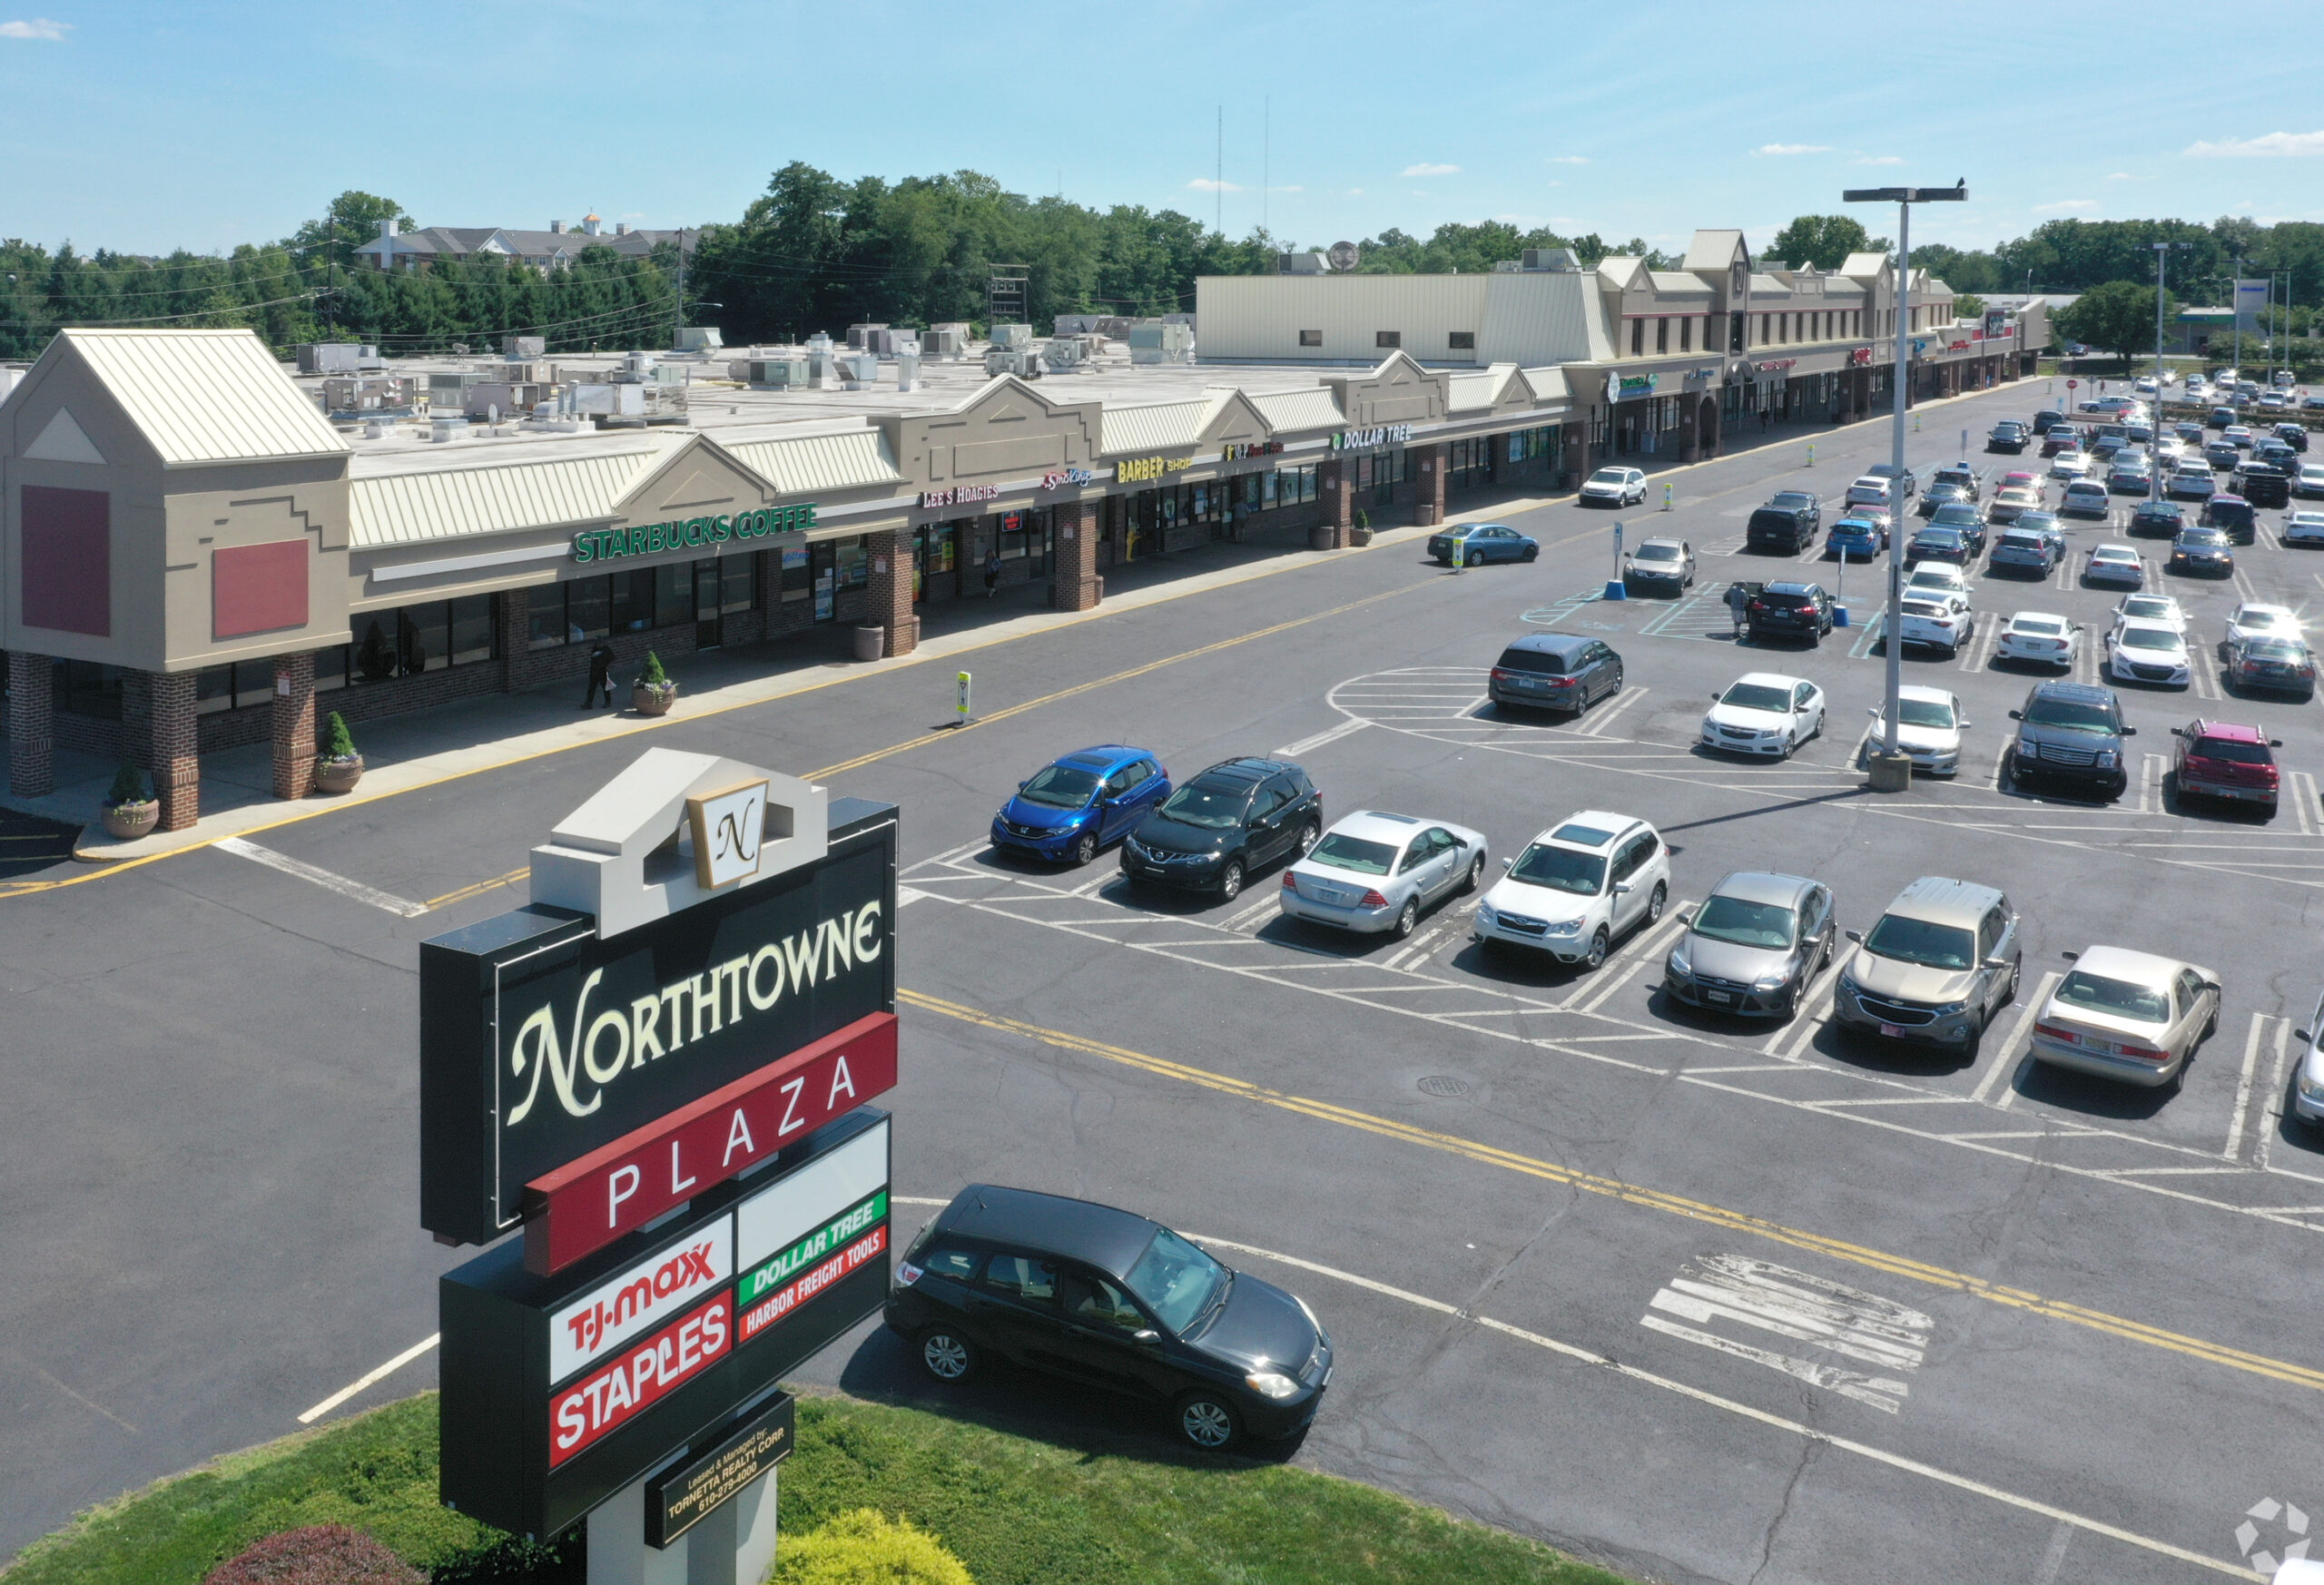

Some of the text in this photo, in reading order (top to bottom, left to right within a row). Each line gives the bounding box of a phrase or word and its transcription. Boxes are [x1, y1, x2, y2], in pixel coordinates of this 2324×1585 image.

[1118, 456, 1192, 484] BARBER SHOP
[1344, 424, 1413, 450] DOLLAR TREE
[923, 485, 1000, 508] LEE'S HOAGIES
[574, 502, 818, 563] STARBUCKS COFFEE
[715, 796, 755, 863] N
[506, 900, 882, 1128] NORTHTOWNE
[609, 1055, 856, 1229] PLAZA
[753, 1200, 874, 1295] DOLLAR TREE
[746, 1232, 880, 1334] HARBOR FREIGHT TOOLS
[556, 1304, 726, 1450] STAPLES
[668, 1475, 721, 1519] TORNETTA
[722, 1447, 757, 1481] REALTY
[688, 1427, 768, 1490] Leased & Managed by:
[698, 1461, 758, 1512] 610-279-4000
